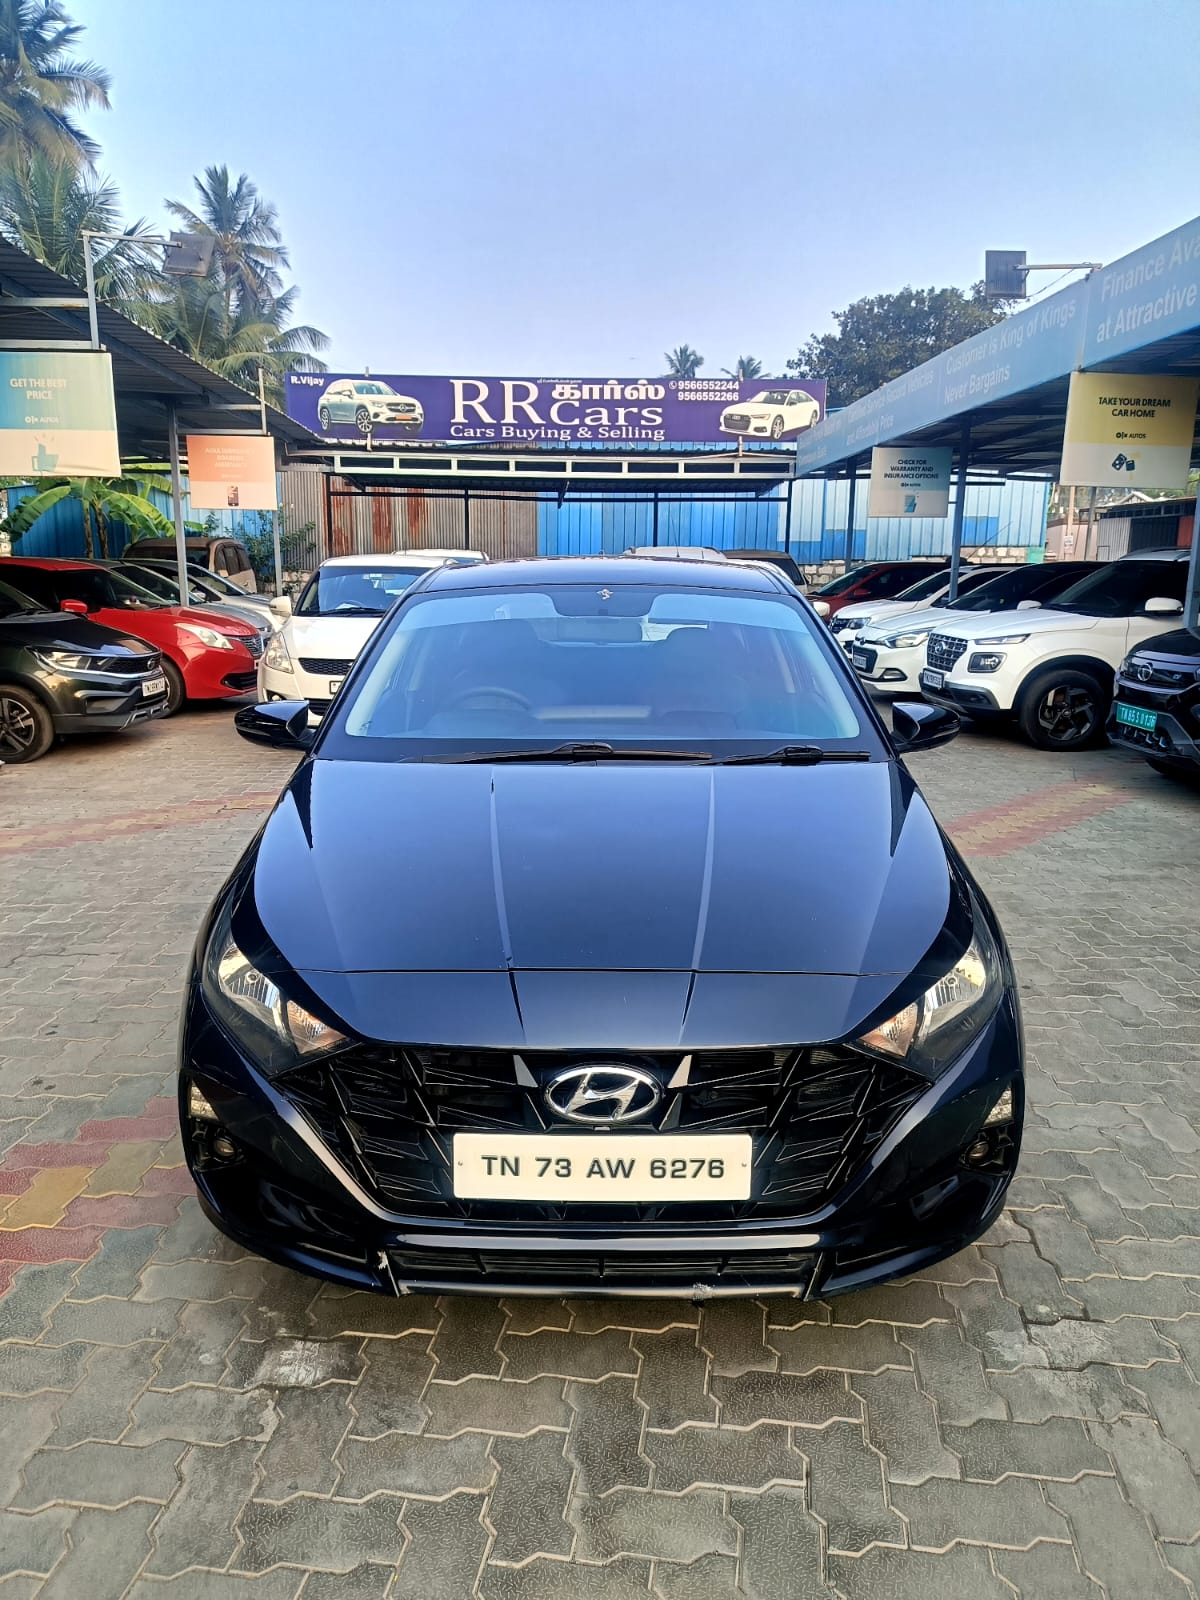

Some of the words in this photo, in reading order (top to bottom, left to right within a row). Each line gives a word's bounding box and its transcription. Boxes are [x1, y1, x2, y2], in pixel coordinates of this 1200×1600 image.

[1101, 253, 1165, 303] Finance
[1097, 315, 1111, 342] at
[1113, 283, 1198, 337] Attractive
[945, 344, 986, 375] Customer
[989, 335, 998, 354] is
[1000, 325, 1024, 350] King
[1027, 312, 1039, 337] of
[1040, 300, 1077, 333] Kings
[10, 378, 27, 388] GET
[28, 378, 46, 388] THE
[290, 376, 325, 386] R.Vijay
[551, 379, 665, 400] கார்ஸ்
[677, 380, 740, 390] 9566552244
[944, 384, 967, 405] Never
[969, 364, 1010, 395] Bargains
[26, 390, 52, 400] PRICE
[449, 379, 547, 424] RR
[677, 391, 740, 401] 9566552266
[1099, 397, 1118, 406] TAKE
[1119, 397, 1142, 407] YOUR
[1142, 399, 1171, 408] DREAM
[549, 400, 663, 426] Cars
[1112, 409, 1129, 417] CAR
[1130, 409, 1157, 418] HOME
[450, 425, 495, 437] Cars
[501, 425, 572, 441] Buying
[577, 426, 592, 438] &
[598, 426, 665, 441] Selling
[481, 1154, 520, 1177] TN
[534, 1157, 573, 1178] 73
[585, 1157, 636, 1179] AW
[649, 1158, 726, 1179] 6276
